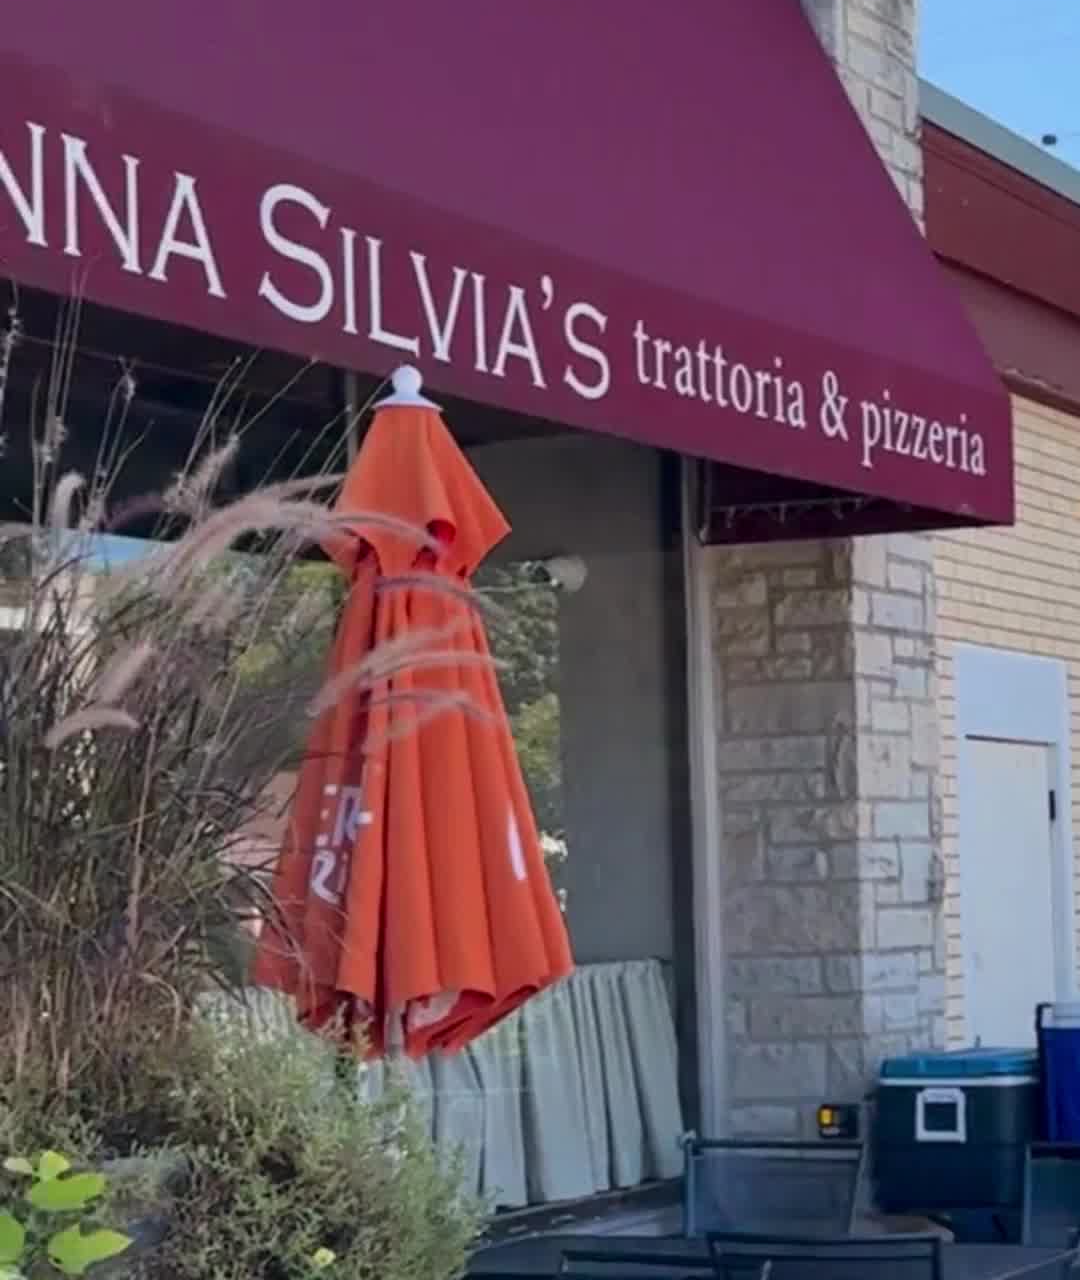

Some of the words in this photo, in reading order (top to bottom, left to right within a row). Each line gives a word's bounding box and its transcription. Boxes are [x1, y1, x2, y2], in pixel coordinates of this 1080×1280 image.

[258, 183, 611, 399] SILVIA'S
[633, 319, 807, 429] trattoria
[819, 369, 850, 442] &
[860, 389, 987, 476] pizzeria
